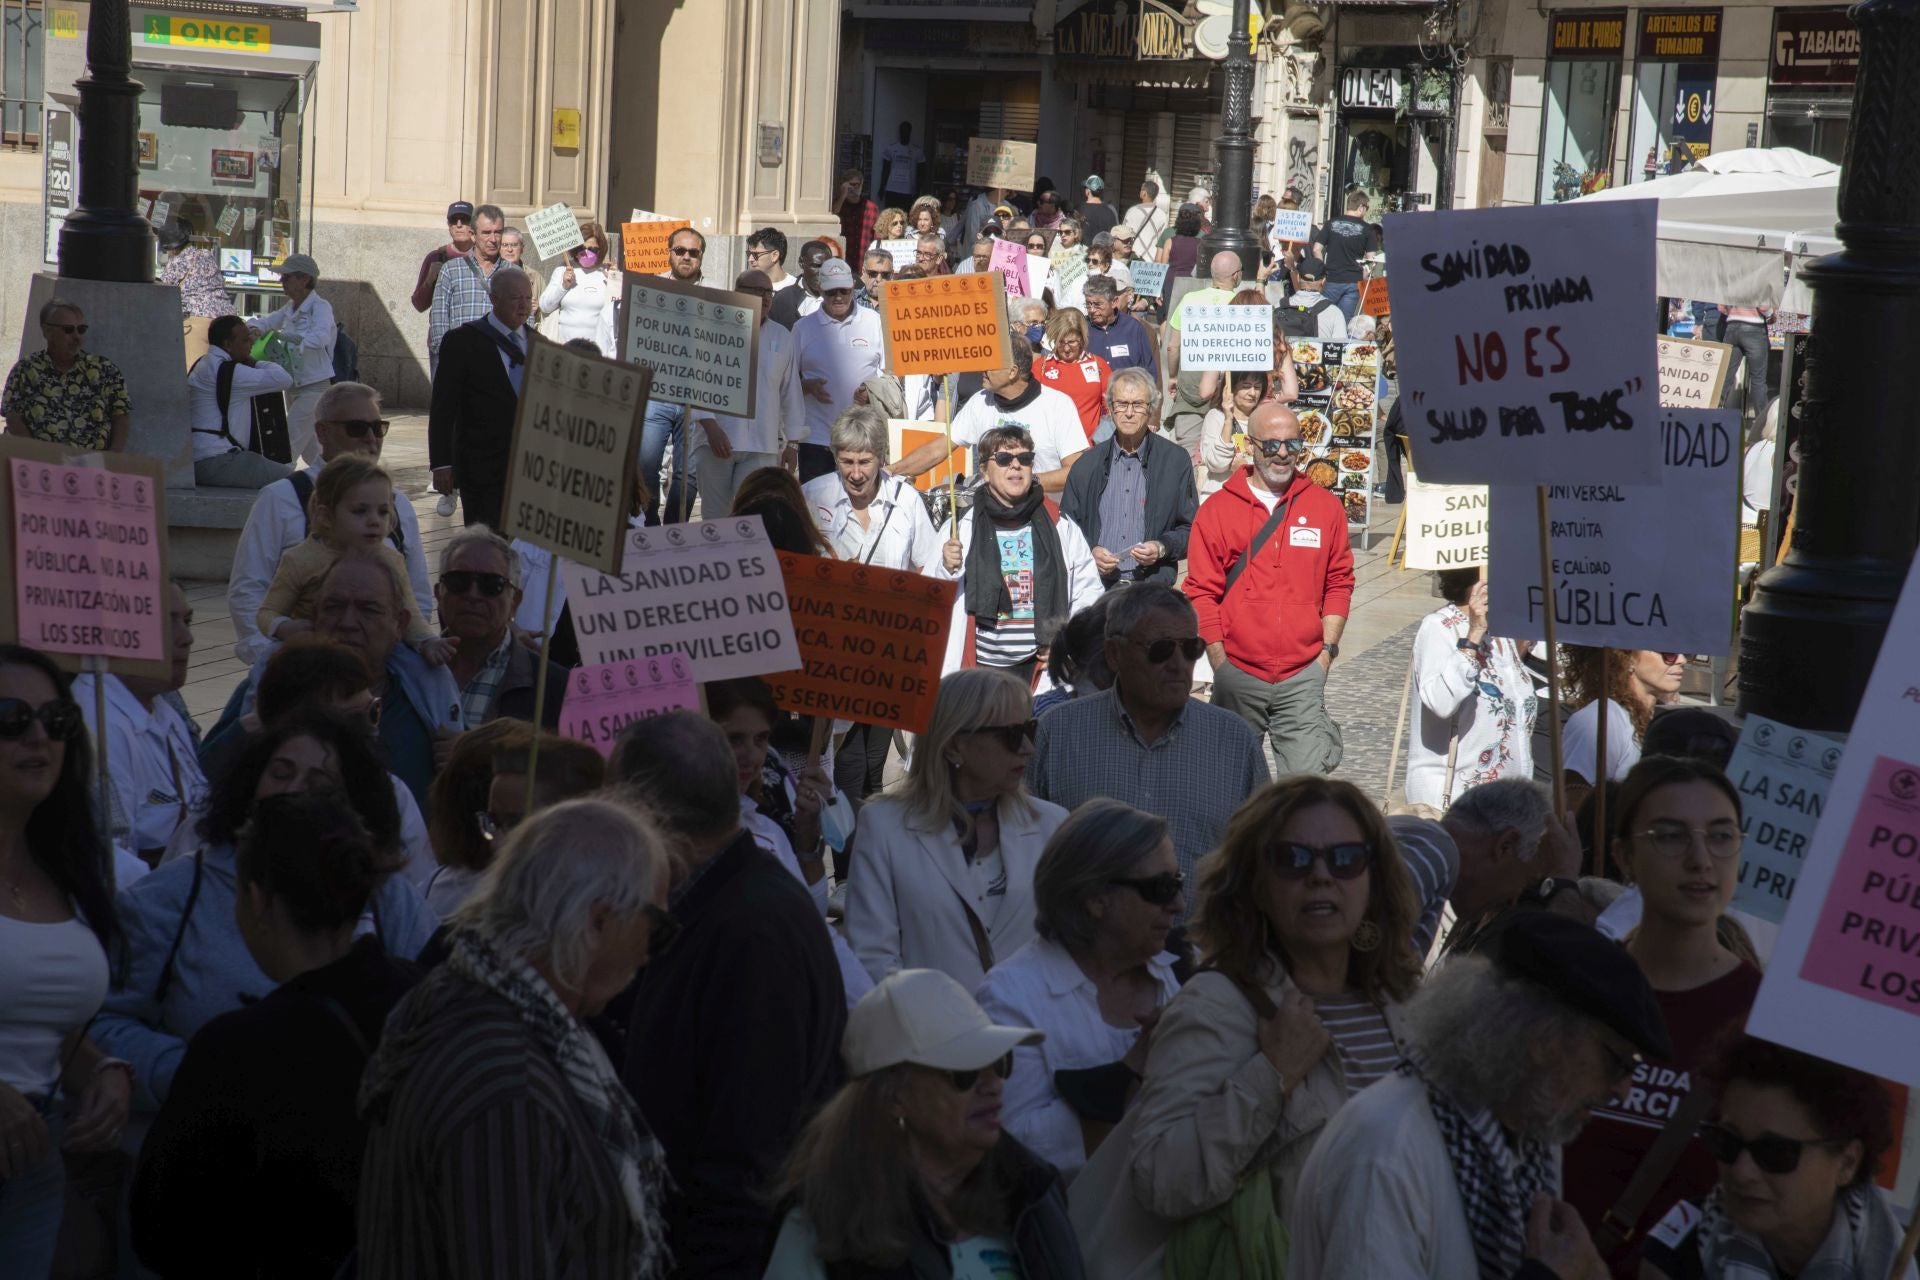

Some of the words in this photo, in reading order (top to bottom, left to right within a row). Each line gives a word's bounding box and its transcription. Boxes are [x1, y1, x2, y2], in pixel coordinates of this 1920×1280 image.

[180, 22, 259, 46] ONCE
[1555, 22, 1576, 48] CAVA
[1579, 22, 1591, 48] DE
[1592, 21, 1622, 48] PUROS
[1647, 15, 1702, 33] ARTICULOS
[1703, 15, 1717, 32] DE
[1655, 37, 1704, 55] FUMADOR
[1799, 30, 1860, 53] TABACOS
[1342, 67, 1394, 107] OLEA
[51, 169, 70, 190] 120
[628, 261, 646, 269] UNA
[1421, 240, 1531, 292] SANIDAD
[1504, 275, 1593, 313] PRIVADA
[896, 308, 911, 321] LA
[914, 305, 971, 319] SANIDAD
[975, 302, 988, 315] ES
[635, 316, 659, 330] POR
[662, 322, 691, 338] UNA
[694, 327, 745, 348] SANIDAD
[892, 330, 911, 342] UN
[915, 325, 973, 340] DERECHO
[977, 323, 997, 336] NO
[1188, 323, 1201, 332] LA
[1203, 323, 1251, 332] SANIDAD
[1254, 323, 1266, 332] ES
[636, 336, 692, 359] PÚBLICA.
[695, 348, 711, 363] NO
[713, 354, 722, 365] A
[725, 354, 741, 369] LA
[901, 350, 920, 363] UN
[924, 345, 993, 361] PRIVILEGIO
[1183, 338, 1199, 347] UN
[1202, 338, 1252, 347] DERECHO
[1255, 338, 1271, 347] NO
[1455, 331, 1507, 385] NO
[1525, 326, 1570, 377] ES
[1188, 353, 1204, 362] UN
[1207, 353, 1267, 362] PRIVILEGIO
[726, 376, 742, 389] DE
[1659, 366, 1709, 383] ANIDAD
[649, 381, 666, 394] OS
[668, 384, 729, 407] SERVICIOS
[1673, 386, 1682, 396] A
[1685, 388, 1701, 400] LA
[533, 400, 549, 433] LA
[522, 450, 544, 483] NO
[561, 466, 615, 508] VENDE
[517, 501, 533, 531] SE
[1445, 494, 1487, 511] SAN
[21, 512, 49, 534] POR
[52, 517, 91, 539] UNA
[25, 545, 96, 575] PÚBLICA.
[115, 559, 126, 579] A
[130, 560, 149, 580] LA
[1564, 556, 1612, 575] CALIDAD
[581, 575, 615, 598] LA
[619, 560, 731, 593] SANIDAD
[739, 556, 765, 579] ES
[134, 595, 153, 616] DE
[579, 611, 618, 636] UN
[624, 596, 740, 631] DERECHO
[746, 590, 784, 615] NO
[791, 596, 835, 619] UNA
[841, 600, 940, 637] SANIDAD
[1528, 580, 1667, 626] PÚBLICA
[40, 622, 68, 644] LOS
[842, 634, 876, 657] NO
[882, 641, 904, 662] A
[904, 643, 929, 666] LA
[901, 674, 929, 697] DE
[791, 687, 902, 721] SERVICIOS
[1739, 770, 1769, 800] LA
[1755, 821, 1806, 858] DER
[1752, 867, 1796, 900] PRI
[1631, 1063, 1691, 1093] SIDA
[1608, 1086, 1681, 1119] RCI
